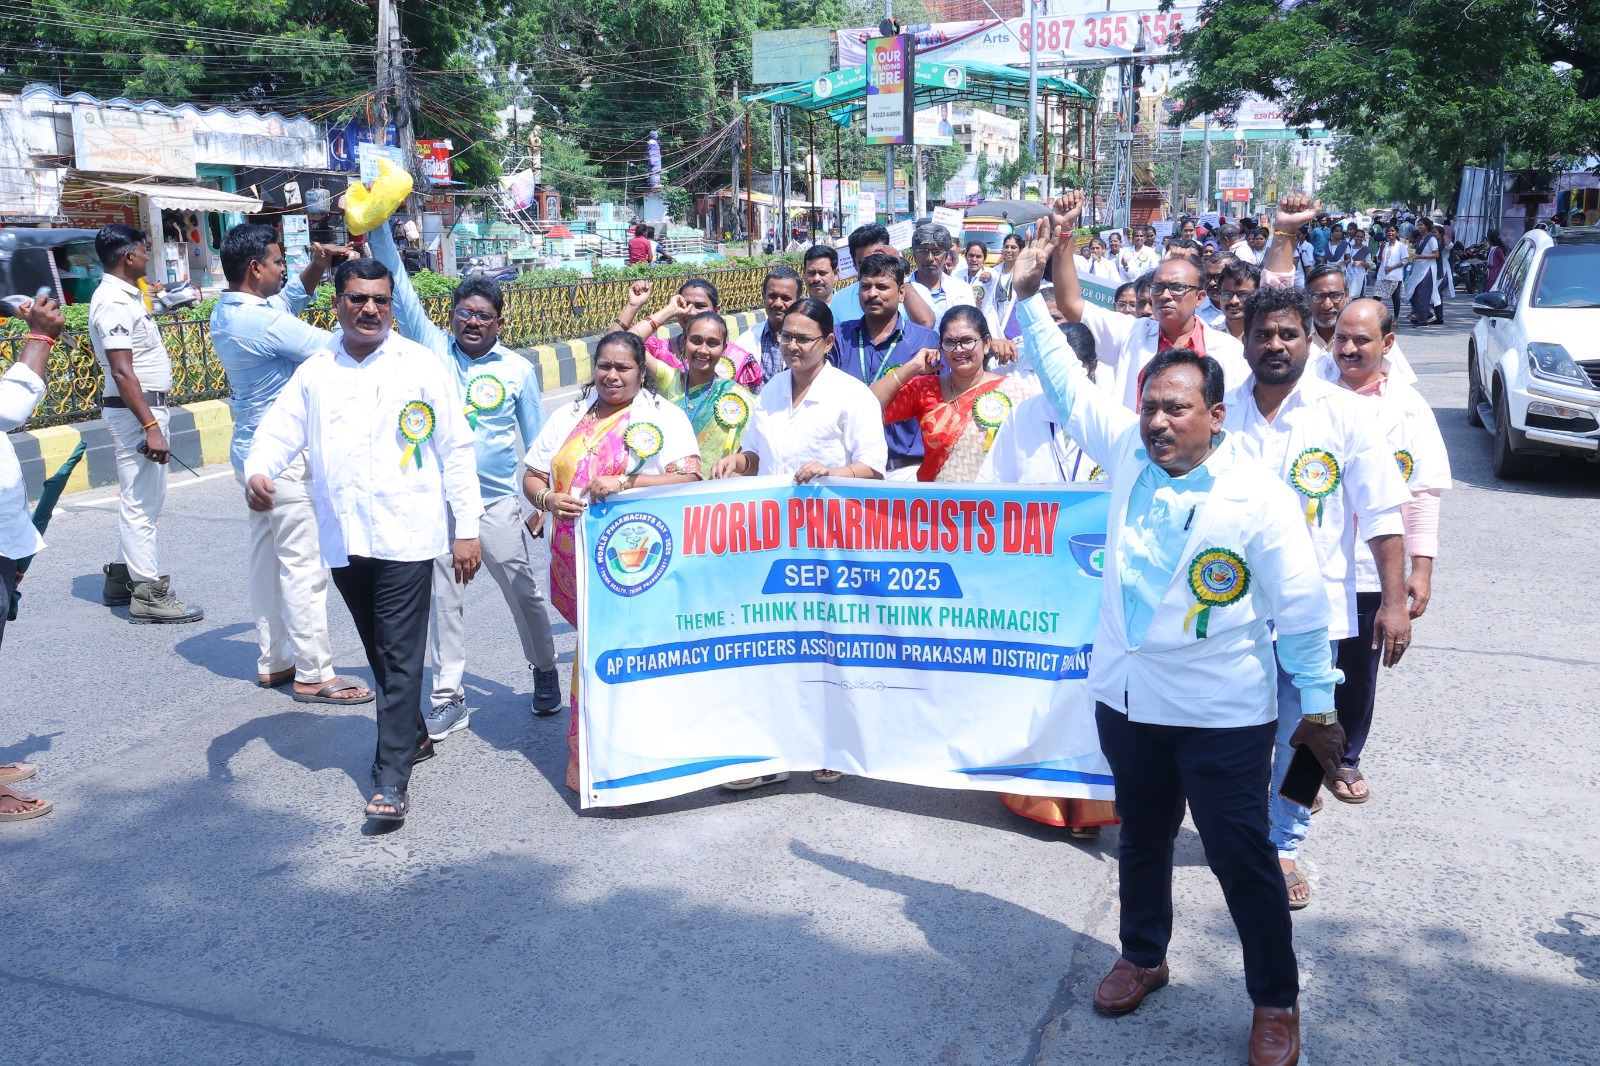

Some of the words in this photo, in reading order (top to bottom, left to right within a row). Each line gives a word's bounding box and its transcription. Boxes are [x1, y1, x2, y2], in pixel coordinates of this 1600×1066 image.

[983, 33, 1010, 44] Arts
[1084, 16, 1127, 48] 355
[870, 63, 901, 72] BRANDING
[871, 49, 901, 64] YOUR
[870, 71, 901, 86] HERE
[597, 535, 608, 564] WORLD
[607, 513, 657, 536] PHARMACISTS
[656, 521, 668, 533] DAY
[682, 500, 782, 556] WORLD
[787, 497, 996, 554] PHARMACISTS
[1003, 501, 1060, 555] DAY
[784, 563, 830, 587] SEP
[836, 566, 881, 589] 25TH
[887, 567, 941, 591] 2025
[675, 610, 725, 631] THEME
[740, 600, 797, 624] THINK
[803, 601, 870, 624] HEALTH
[876, 604, 933, 627] THINK
[939, 606, 1061, 634] PHARMACIST
[606, 656, 623, 676] AP
[626, 645, 710, 674] PHARMACY
[800, 637, 897, 661] ASSOCIATION
[902, 644, 986, 666] PRAKASAM
[992, 648, 1059, 673] DISTRICT
